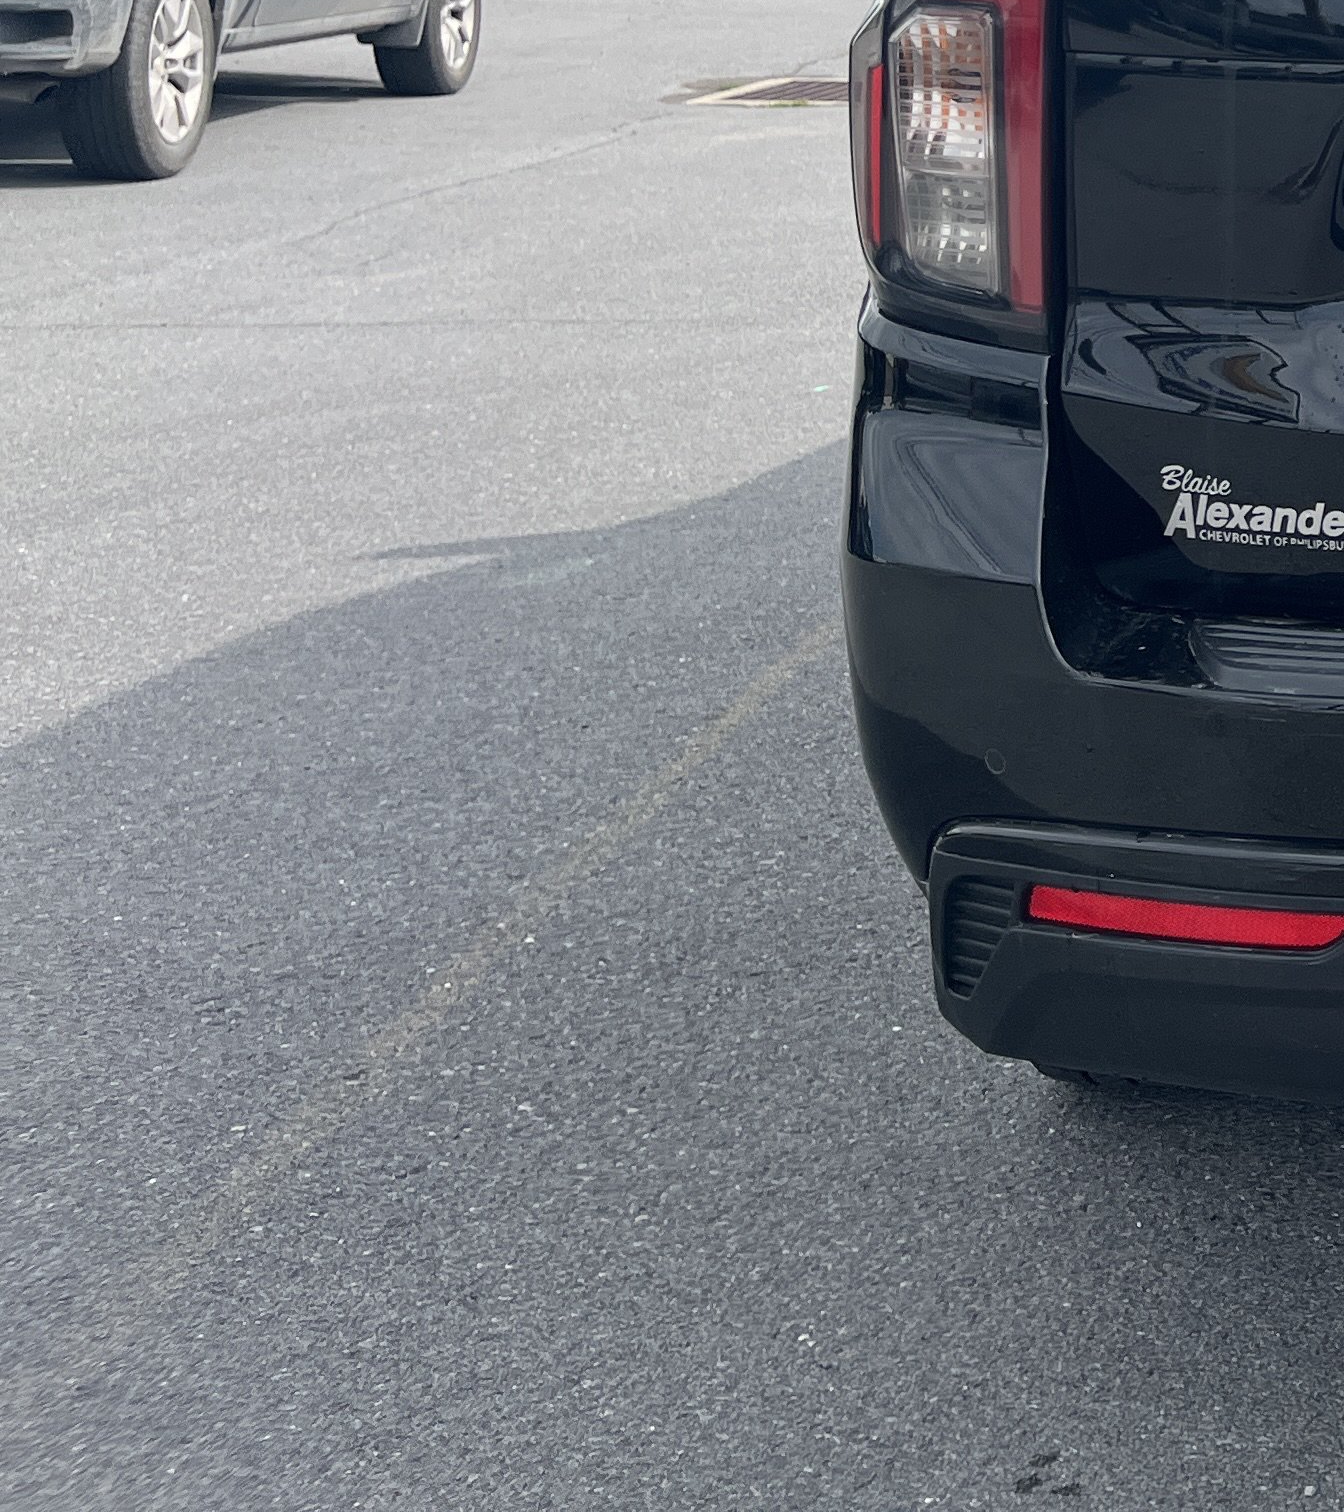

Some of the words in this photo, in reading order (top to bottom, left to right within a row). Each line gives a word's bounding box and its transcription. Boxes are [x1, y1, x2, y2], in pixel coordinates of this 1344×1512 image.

[1160, 464, 1232, 496] Blaise
[1199, 529, 1271, 546] CHEVROLET
[1273, 536, 1289, 547] OF
